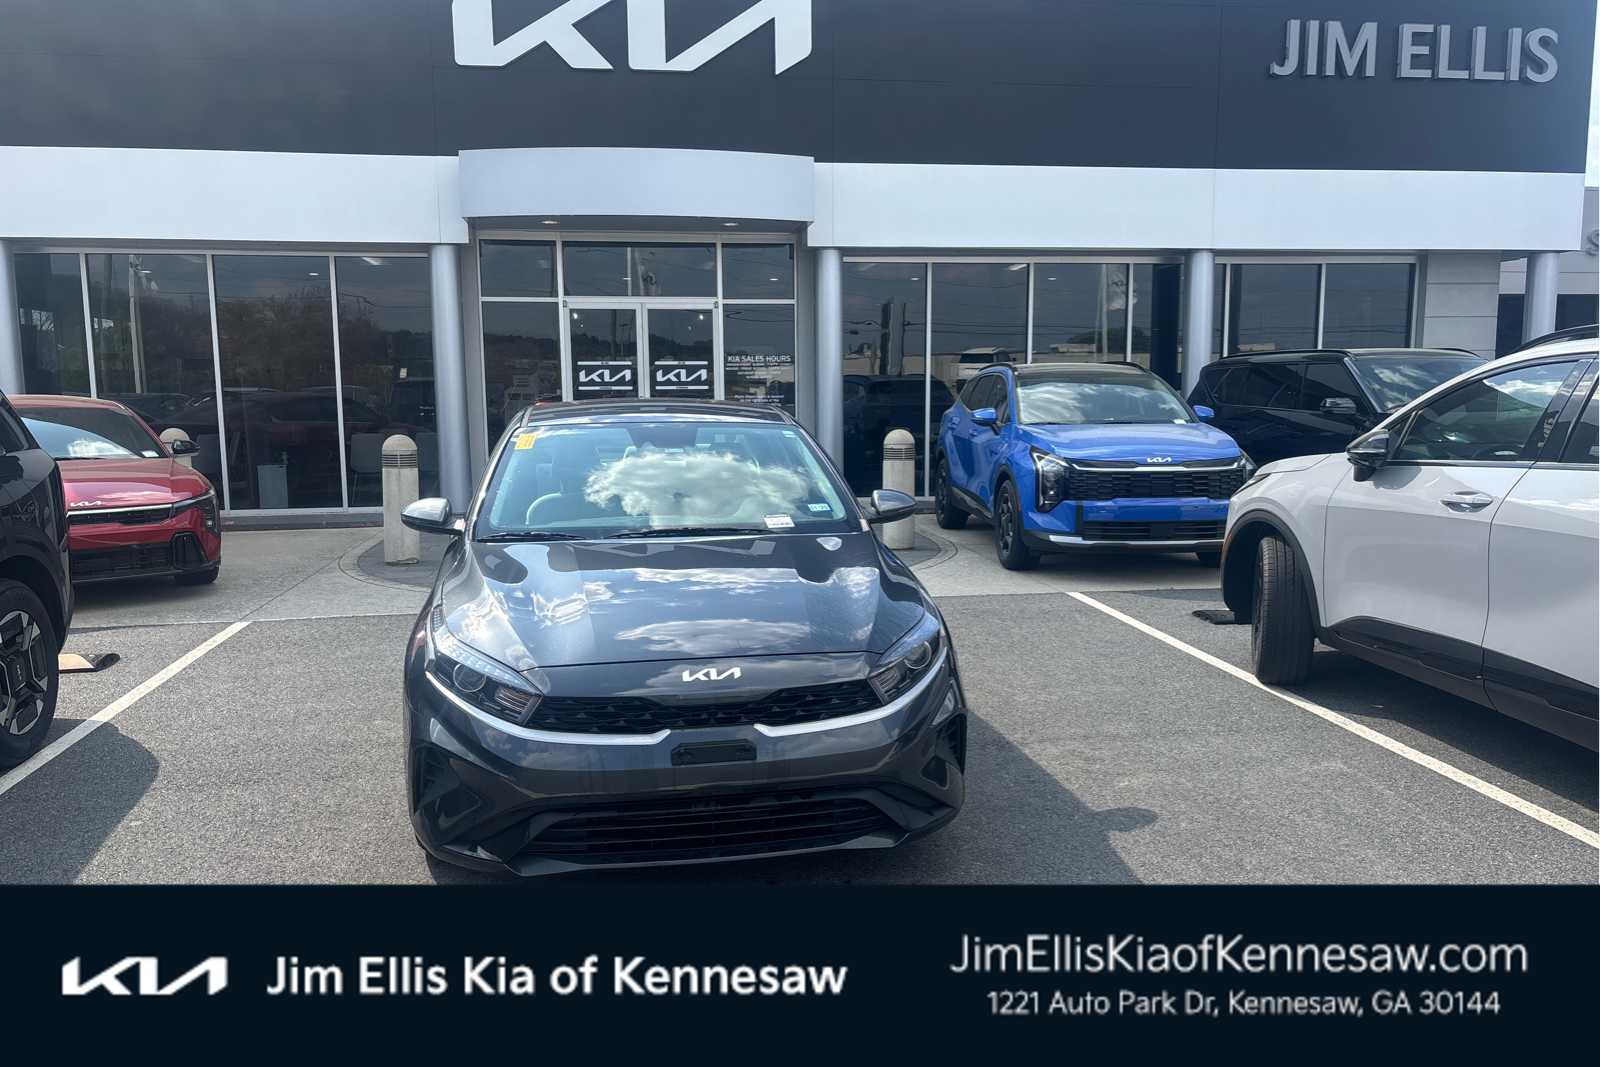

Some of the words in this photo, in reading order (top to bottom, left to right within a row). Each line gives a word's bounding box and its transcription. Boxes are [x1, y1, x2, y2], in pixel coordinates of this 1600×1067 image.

[452, 0, 813, 75] KIA
[1270, 19, 1378, 77] JIM
[1397, 23, 1559, 83] ELLIS
[579, 369, 632, 382] KIA
[656, 368, 708, 382] KIA
[682, 666, 742, 682] KIA
